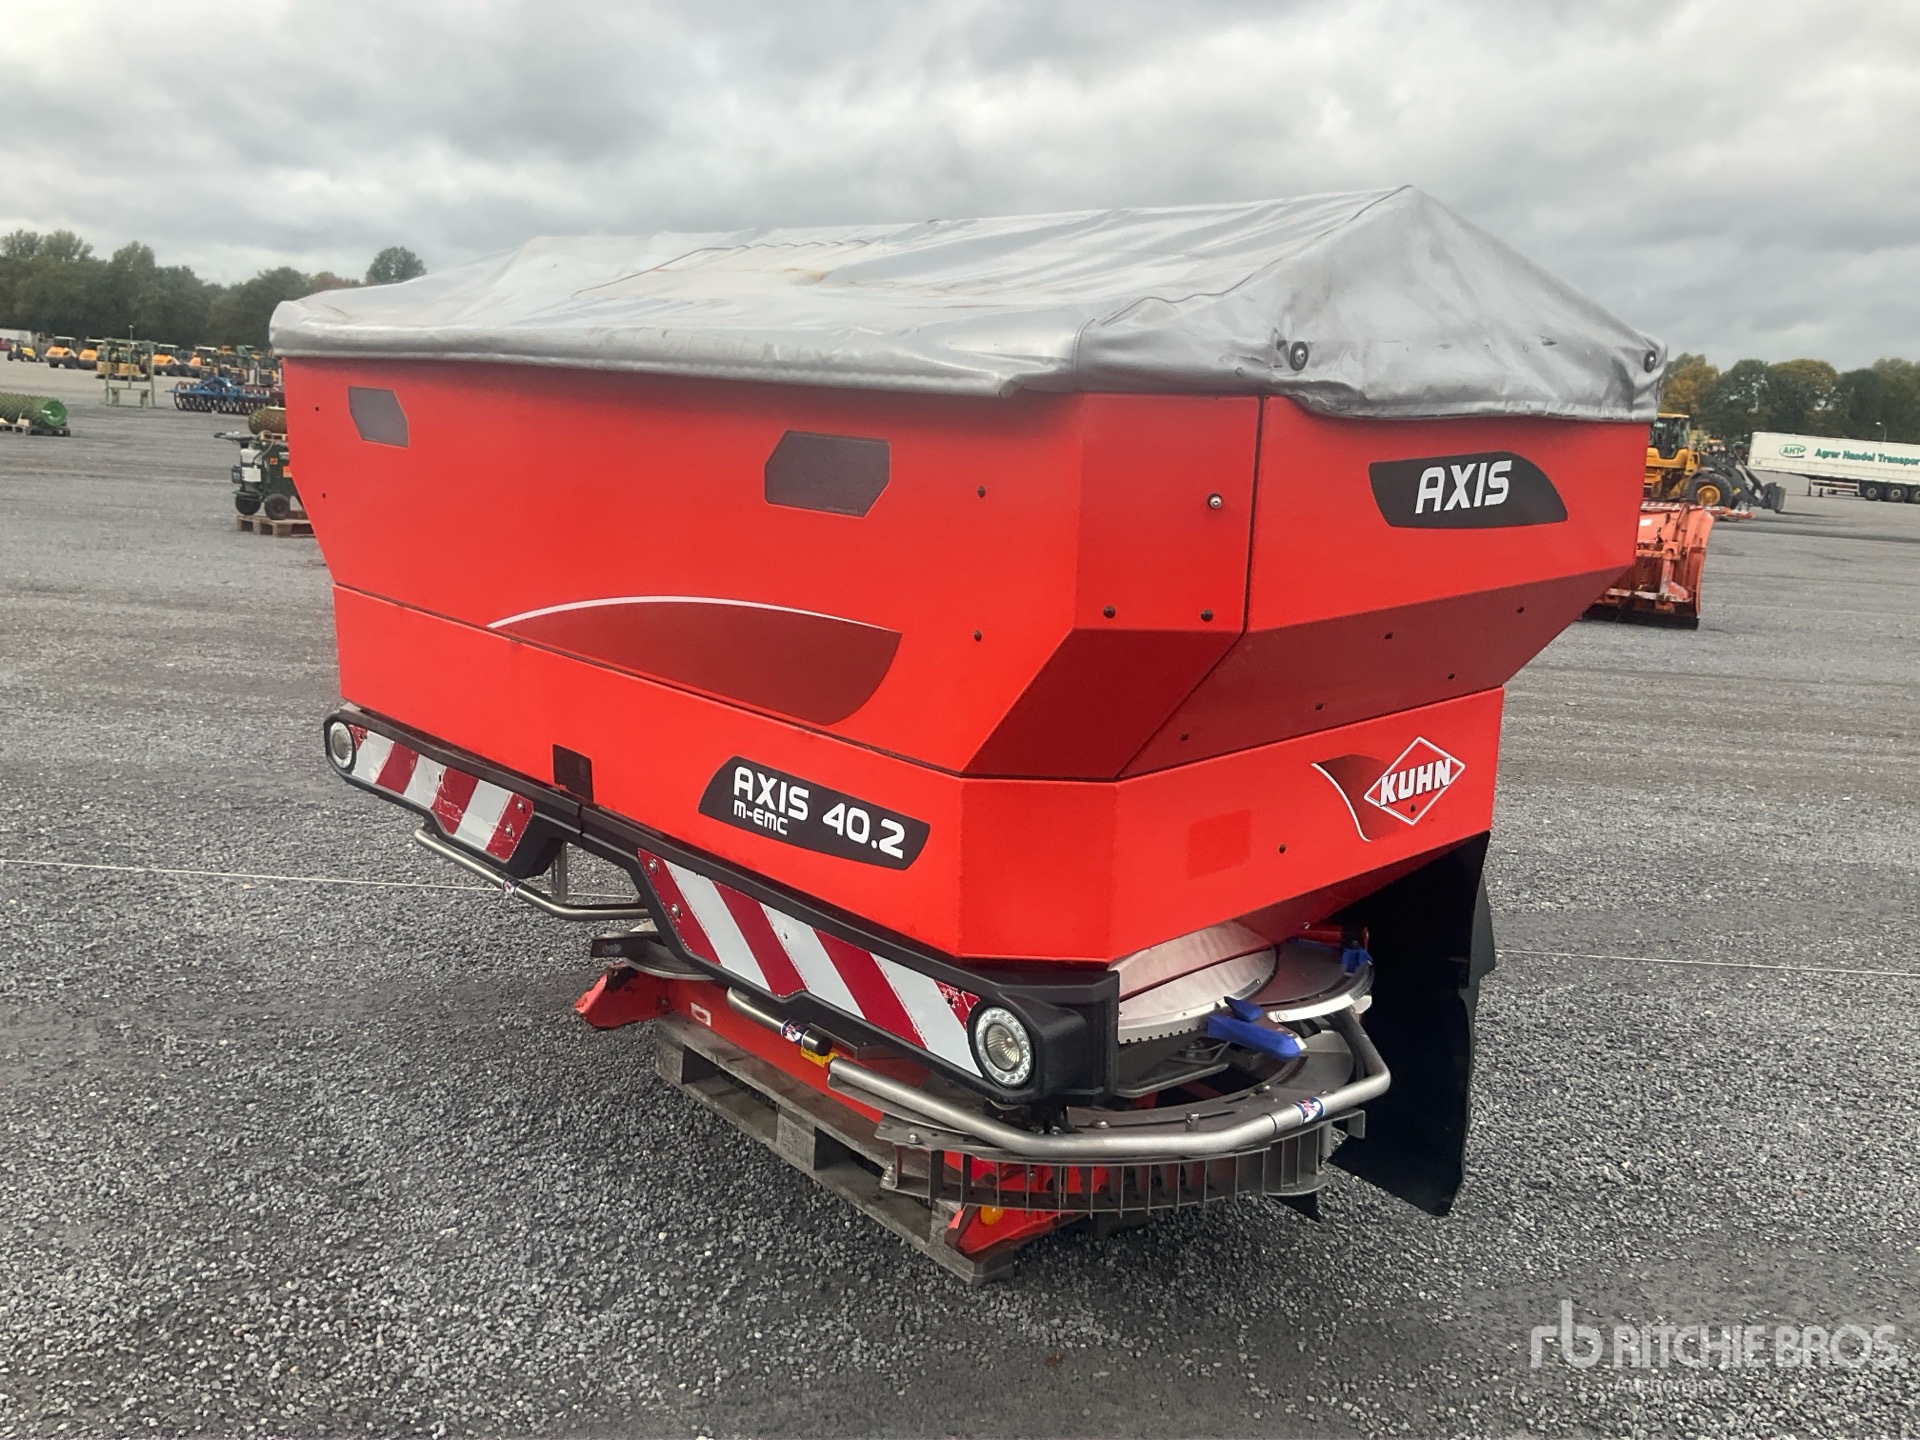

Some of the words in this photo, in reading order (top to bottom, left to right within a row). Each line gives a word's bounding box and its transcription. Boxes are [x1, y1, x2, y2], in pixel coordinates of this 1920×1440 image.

[1782, 446, 1801, 455] AHT
[1843, 450, 1875, 461] Handel
[1415, 460, 1512, 514] AXIS
[1380, 757, 1451, 806] KUHN
[733, 766, 809, 821] AXIS
[822, 803, 905, 859] 40.2
